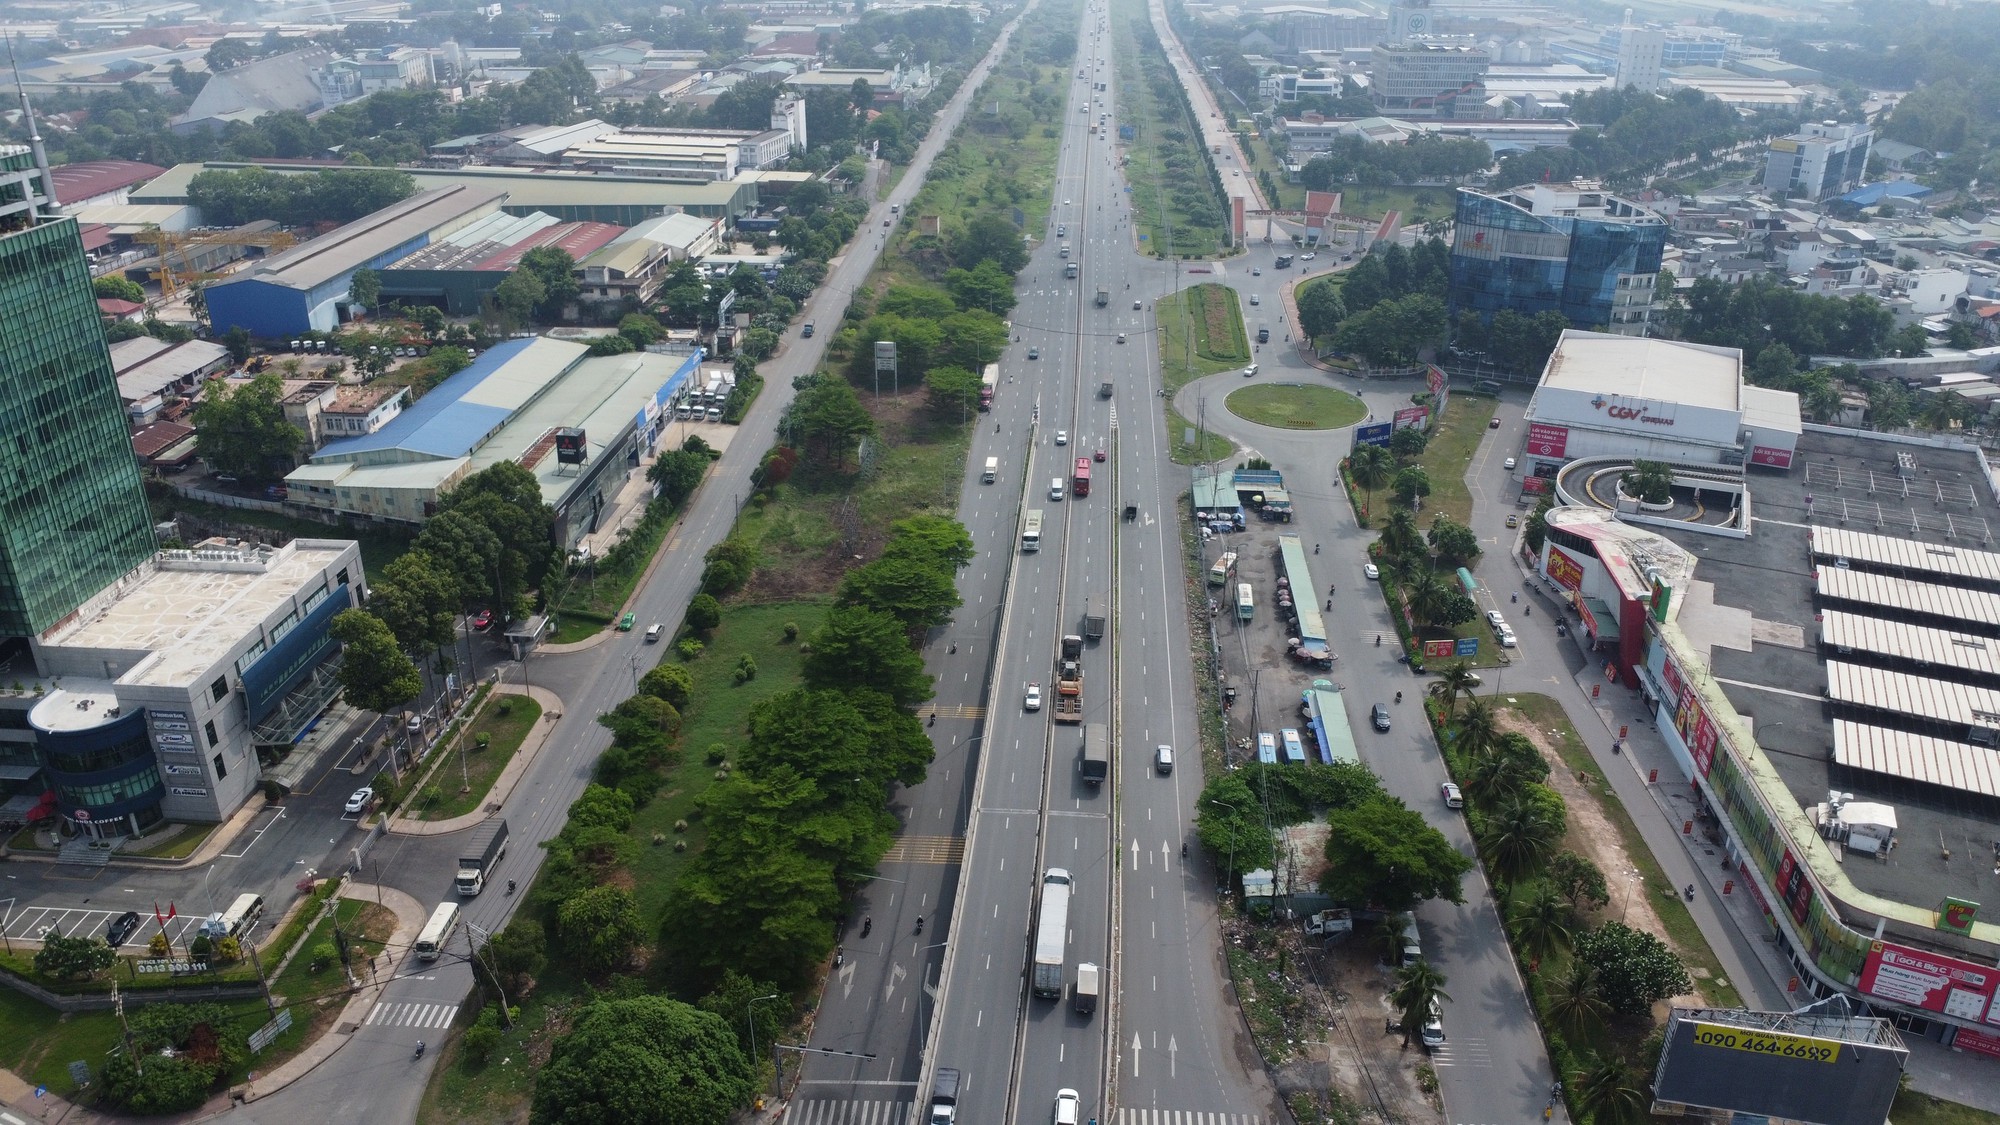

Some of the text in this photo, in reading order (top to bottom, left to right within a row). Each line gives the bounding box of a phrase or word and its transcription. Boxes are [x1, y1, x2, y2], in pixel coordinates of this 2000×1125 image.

[1608, 405, 1675, 427] CGV CINEMAS
[94, 815, 123, 825] COFFEE
[138, 964, 166, 973] 0913
[191, 962, 207, 971] 111
[1880, 966, 1895, 974] Mua
[1899, 957, 1915, 966] GO!
[1923, 963, 1937, 973] Big
[1940, 966, 1947, 974] C
[1701, 1032, 1832, 1061] 090 464 6699
